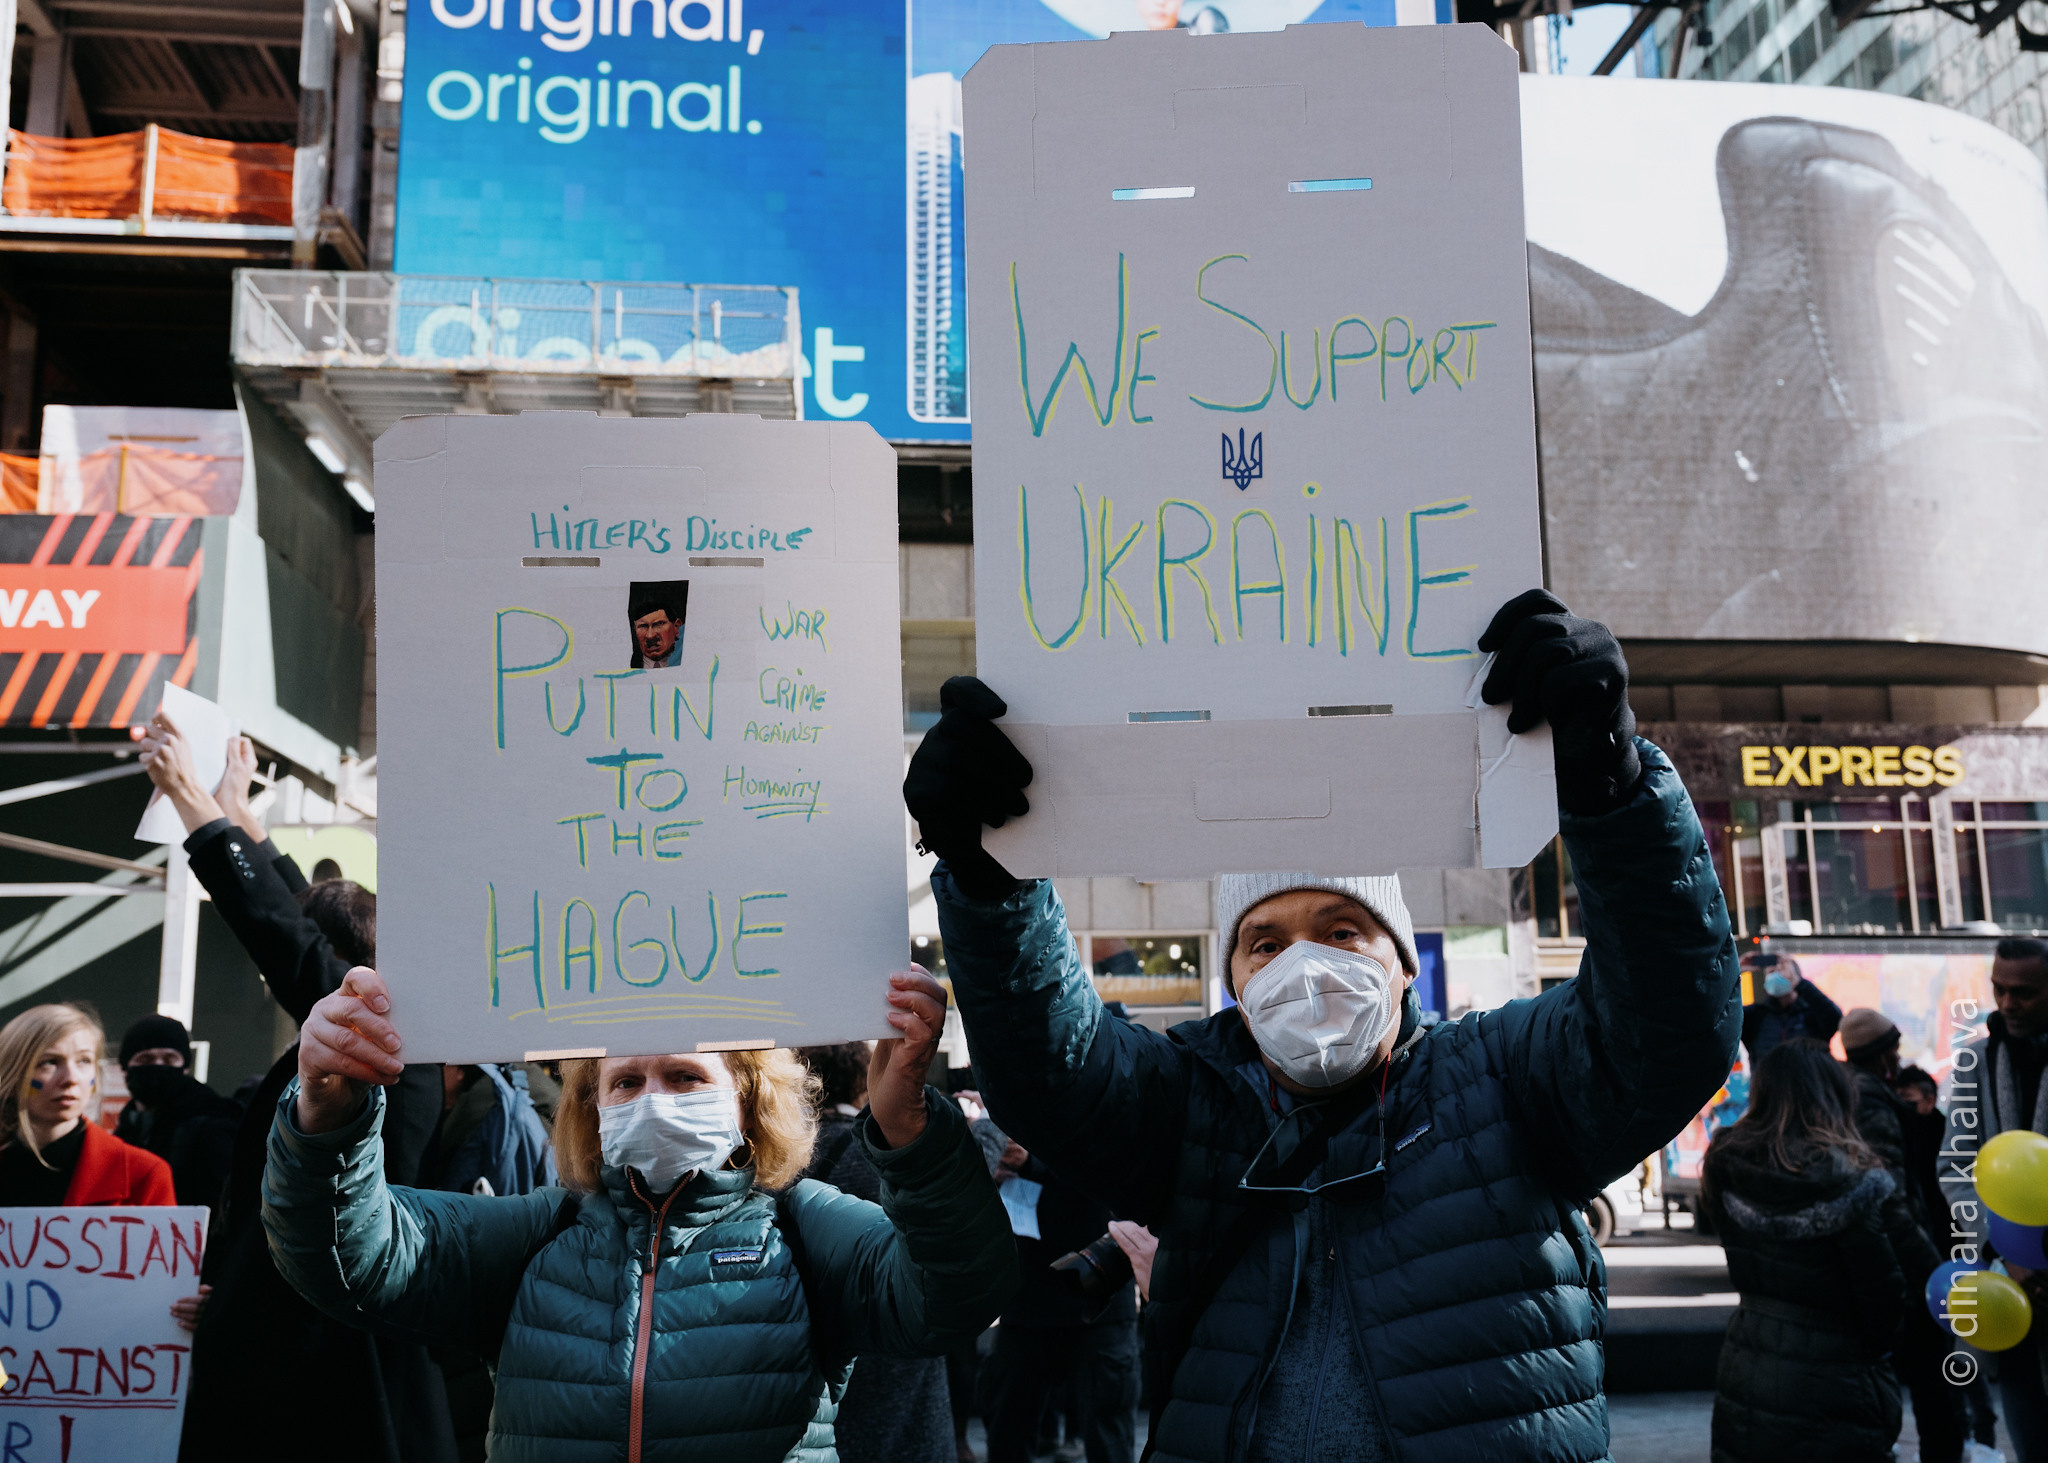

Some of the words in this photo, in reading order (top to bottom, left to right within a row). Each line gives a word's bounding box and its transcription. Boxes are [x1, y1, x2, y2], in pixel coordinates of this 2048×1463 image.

[426, 56, 763, 144] original.
[759, 600, 831, 654] WAR
[492, 606, 719, 756] PUTIN
[585, 747, 688, 812] TO
[1740, 745, 1966, 787] EXPRESS
[555, 812, 704, 873] THE
[485, 881, 789, 1017] HAGUE
[717, 1255, 758, 1263] patagonia
